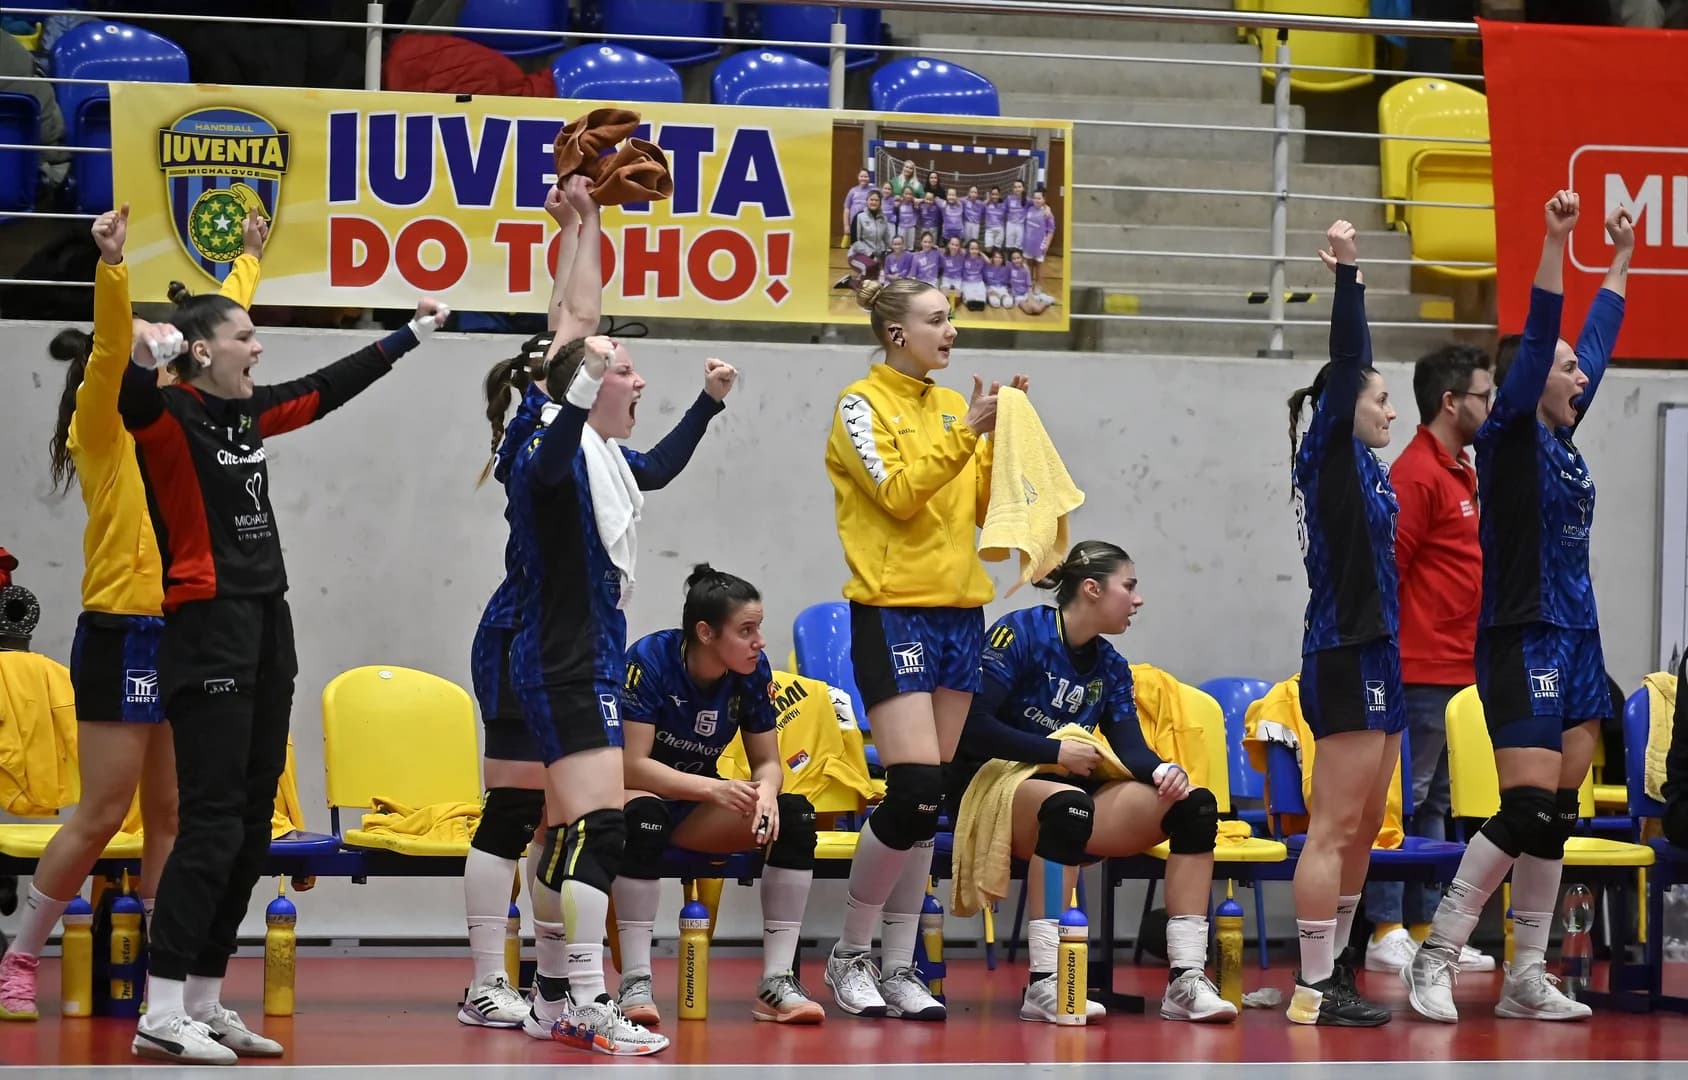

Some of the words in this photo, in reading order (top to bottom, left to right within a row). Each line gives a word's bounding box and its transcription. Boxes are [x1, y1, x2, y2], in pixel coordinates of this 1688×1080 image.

[194, 122, 254, 133] HANDBALL
[163, 133, 284, 167] IUVENTA
[329, 112, 792, 218] IUVETA
[187, 168, 261, 177] MICHALOVCE
[330, 216, 468, 292] DO
[1050, 678, 1085, 714] 14
[694, 710, 719, 737] 6
[918, 803, 938, 811] SELECT
[1069, 807, 1089, 817] SELECT
[640, 822, 662, 831] SELECT
[685, 942, 695, 1009] Chemkostav
[1066, 949, 1077, 1015] Chemkostav
